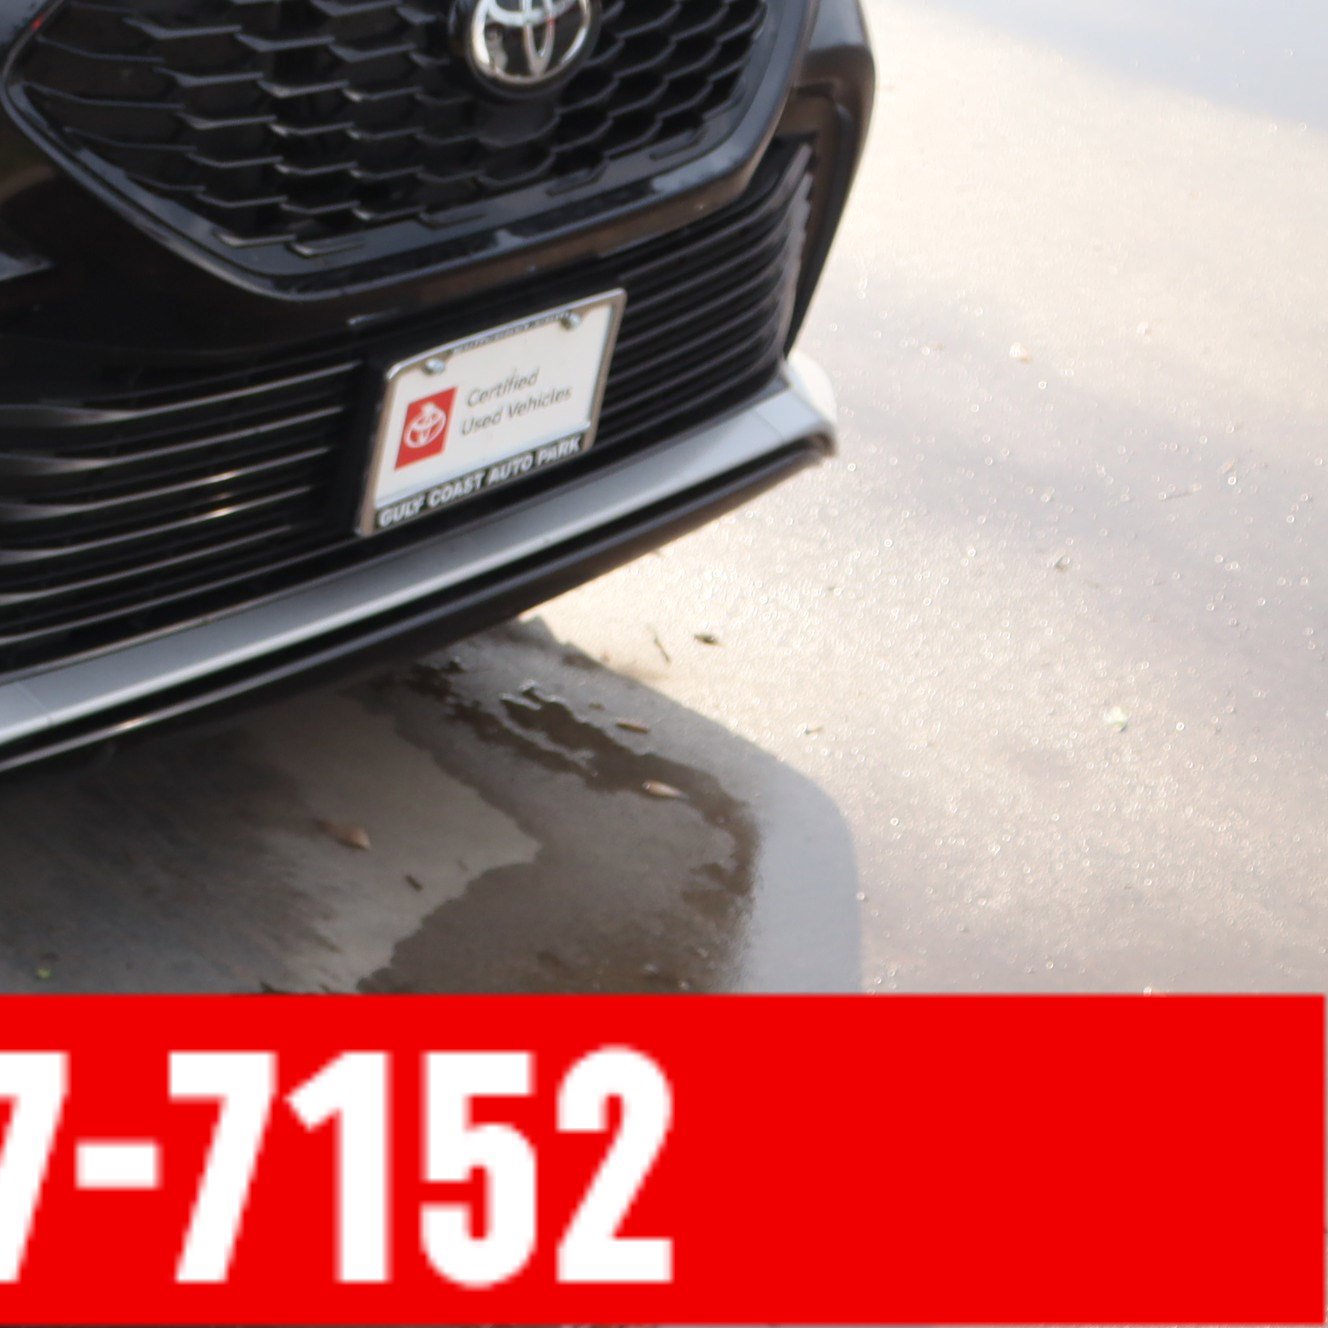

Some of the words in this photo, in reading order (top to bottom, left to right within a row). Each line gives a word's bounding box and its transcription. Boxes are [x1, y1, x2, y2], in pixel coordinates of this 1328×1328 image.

[462, 407, 503, 435] Used
[508, 387, 573, 418] Vehicles
[467, 367, 539, 407] Certified
[428, 472, 485, 508] COAST
[487, 453, 534, 486] AUTO
[537, 436, 582, 468] PARK
